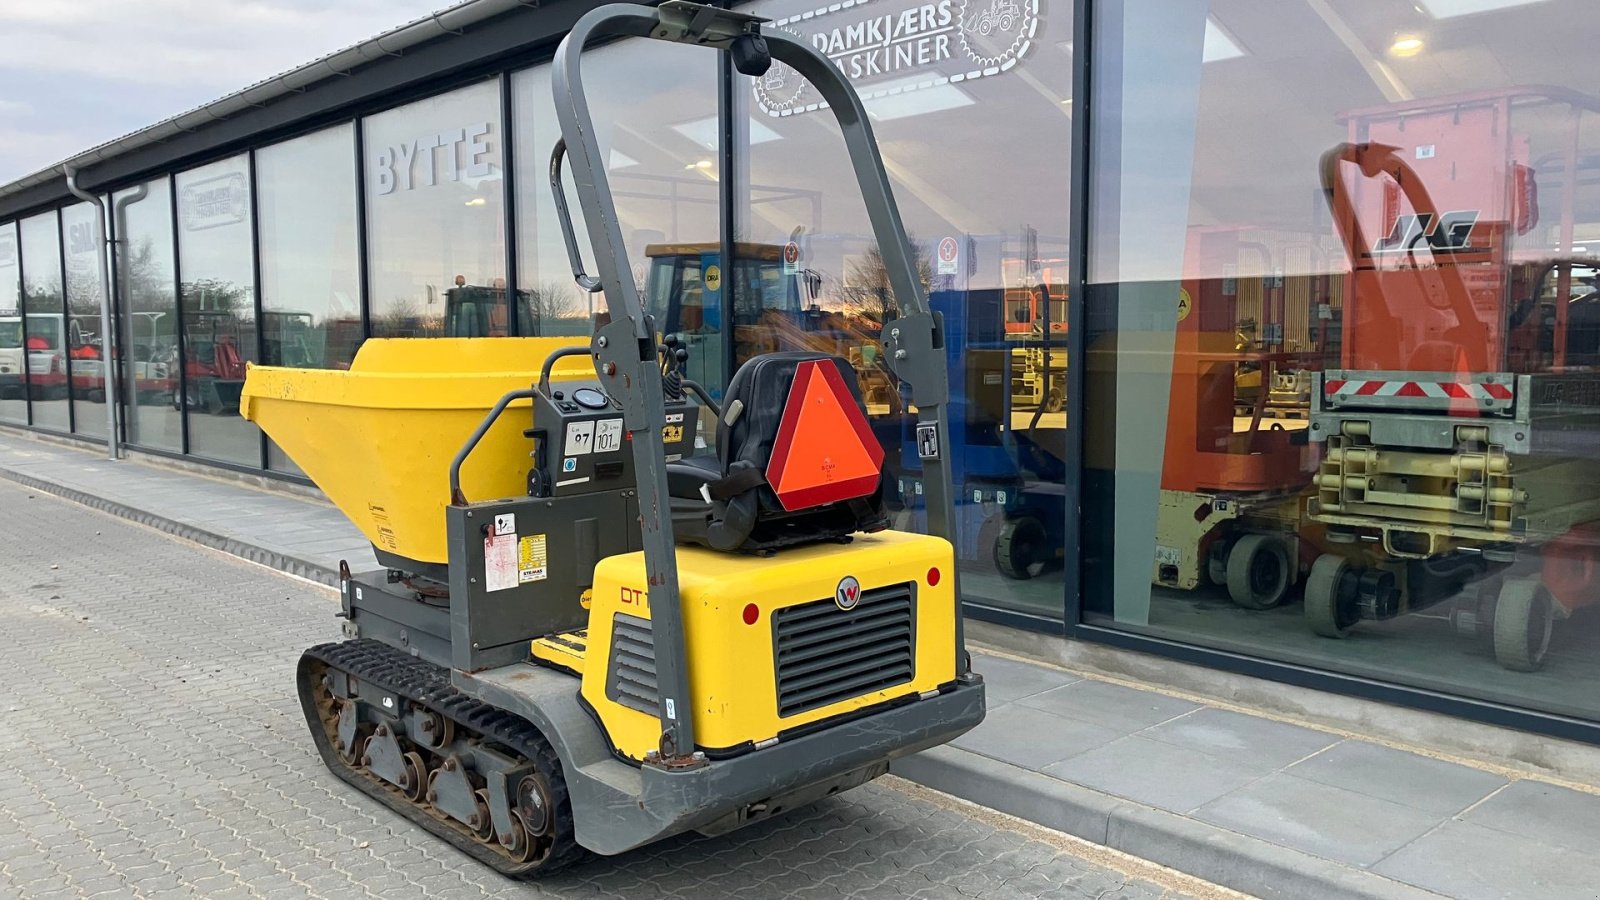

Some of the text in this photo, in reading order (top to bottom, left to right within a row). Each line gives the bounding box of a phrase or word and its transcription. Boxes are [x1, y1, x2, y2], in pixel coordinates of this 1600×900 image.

[812, 0, 952, 54] DAMKJÆRS
[834, 34, 950, 79] ASKINER
[375, 120, 493, 195] BYTTE
[70, 222, 96, 254] SAL
